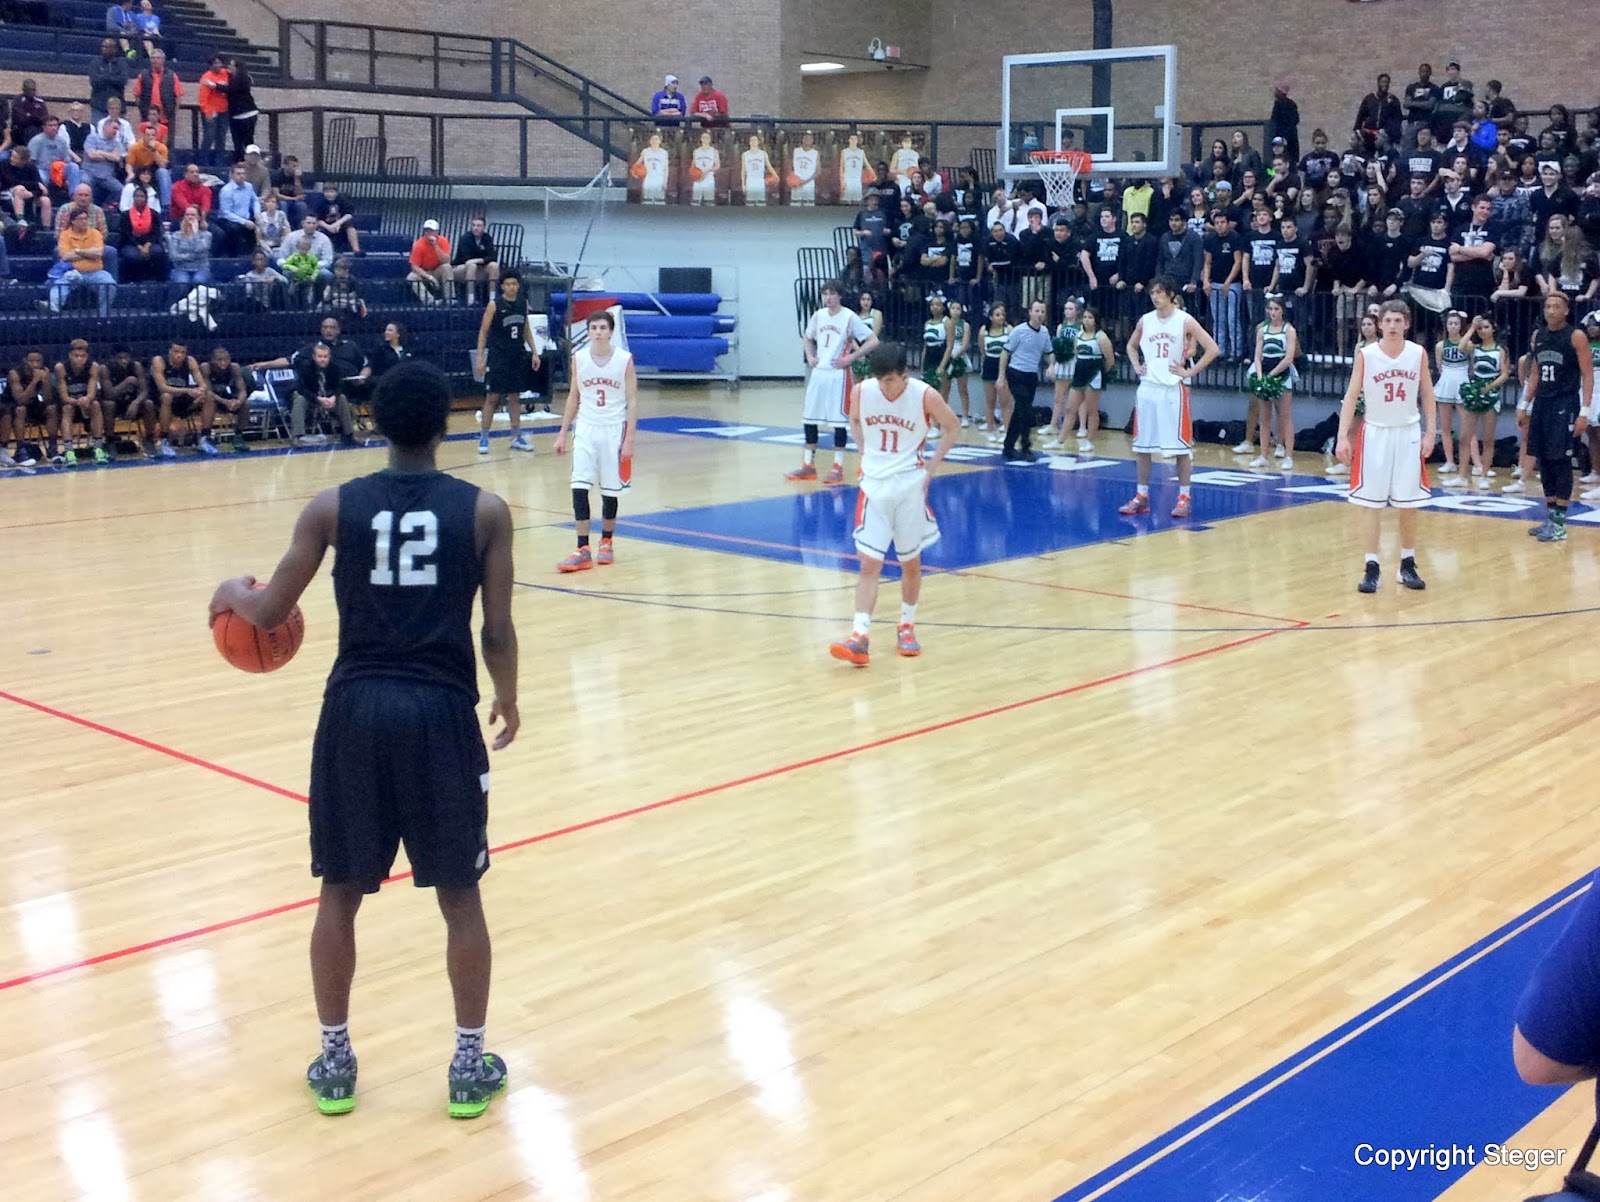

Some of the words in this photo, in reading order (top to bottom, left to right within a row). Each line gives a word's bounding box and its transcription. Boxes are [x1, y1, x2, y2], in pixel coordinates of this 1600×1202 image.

[510, 325, 519, 340] 2
[1156, 342, 1169, 359] 15
[1372, 368, 1417, 384] ROCKWALL
[1541, 364, 1556, 382] 21
[596, 389, 606, 407] 3
[1384, 381, 1406, 402] 34
[865, 414, 915, 432] ROCKWALL
[880, 428, 898, 453] 11
[370, 510, 437, 586] 12
